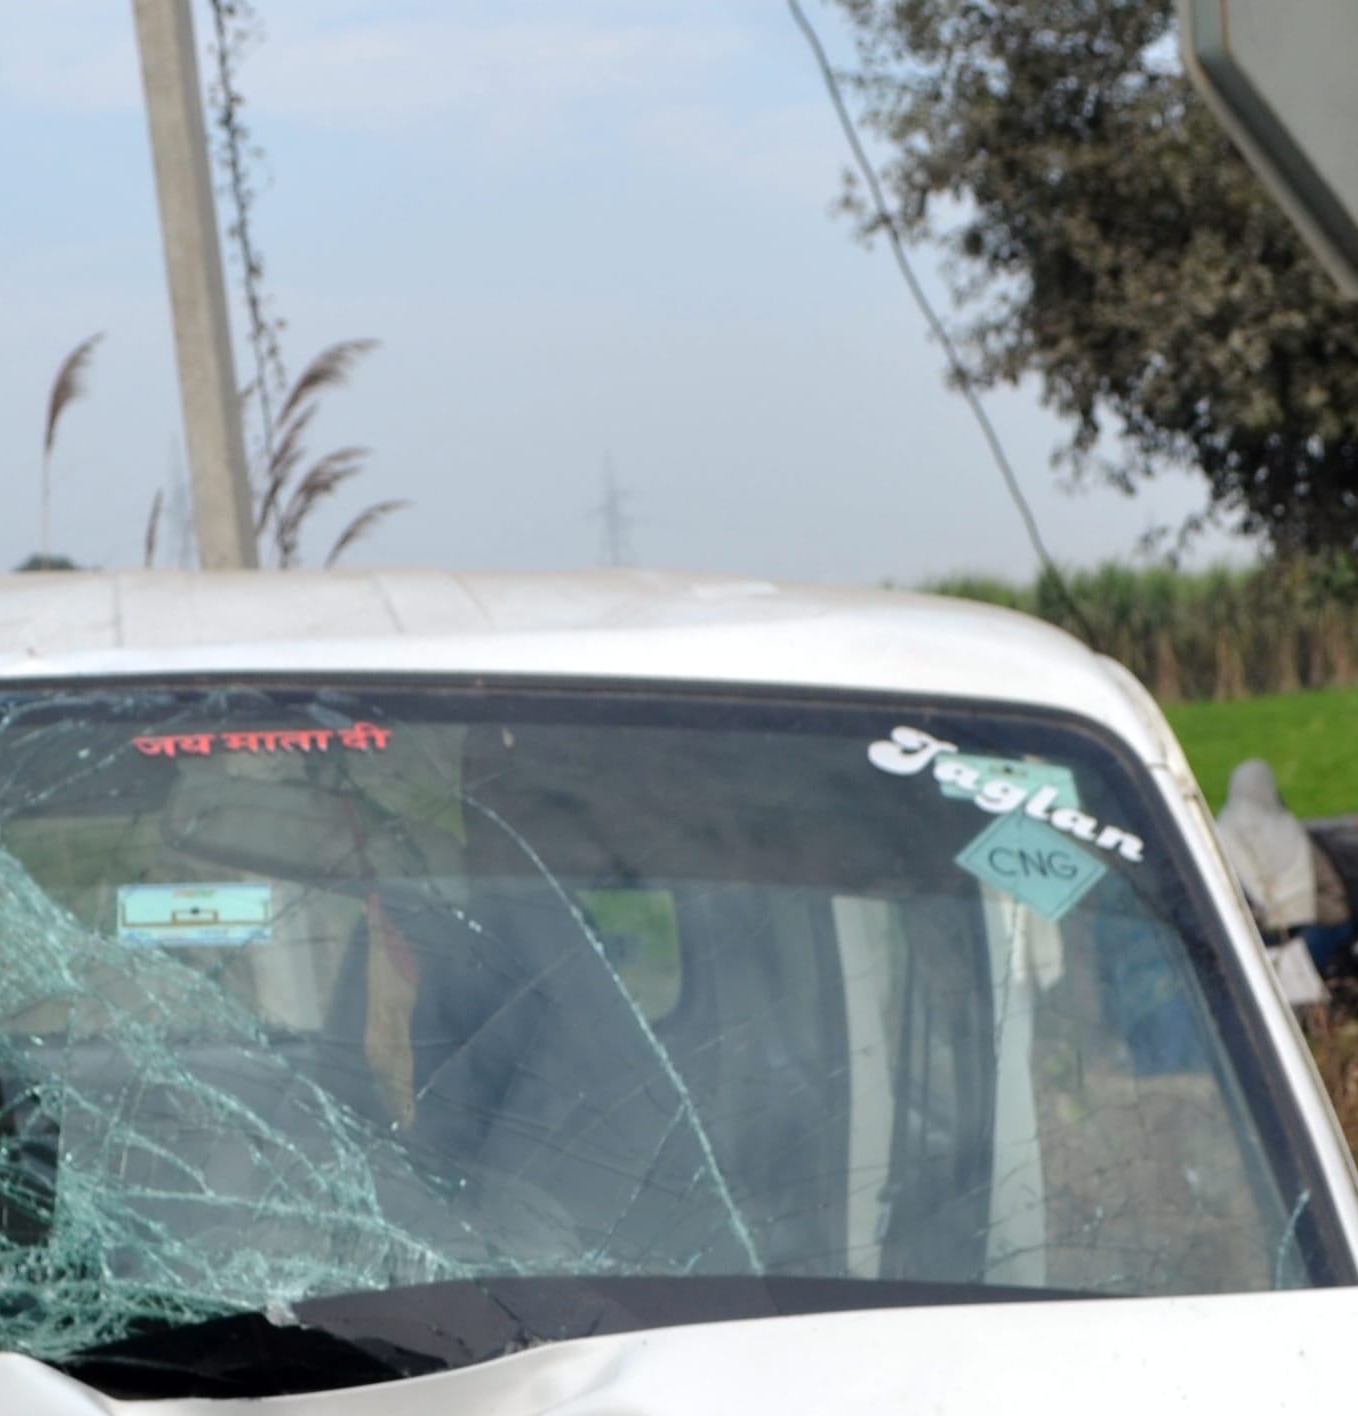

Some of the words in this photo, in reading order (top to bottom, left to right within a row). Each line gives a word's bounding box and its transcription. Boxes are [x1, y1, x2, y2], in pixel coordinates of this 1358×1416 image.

[132, 732, 217, 758] जय
[221, 729, 334, 754] माता
[987, 846, 1079, 880] CNG
